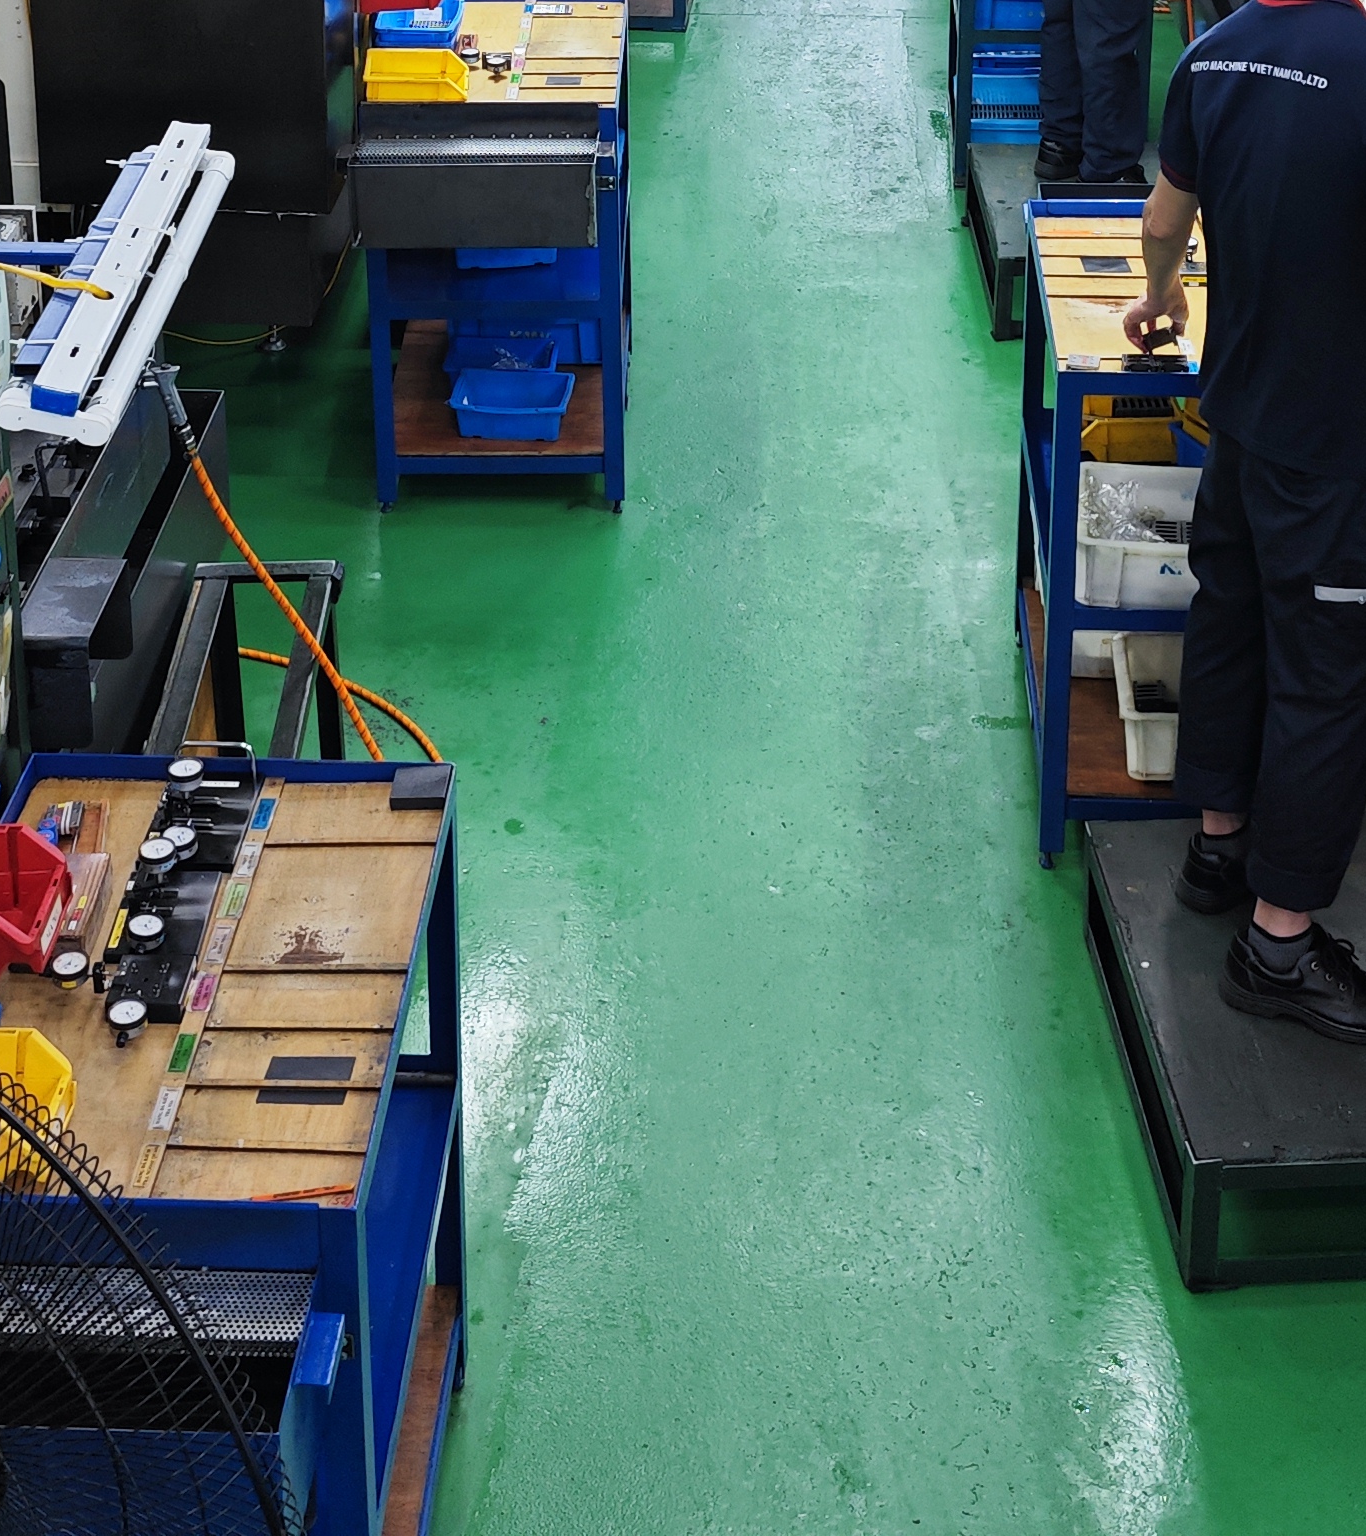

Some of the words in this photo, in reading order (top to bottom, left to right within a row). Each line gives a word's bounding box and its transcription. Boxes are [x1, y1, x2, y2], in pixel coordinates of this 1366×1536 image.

[1210, 61, 1248, 71] MACHINE
[1249, 62, 1274, 76] VIET
[1274, 66, 1291, 80] NAM
